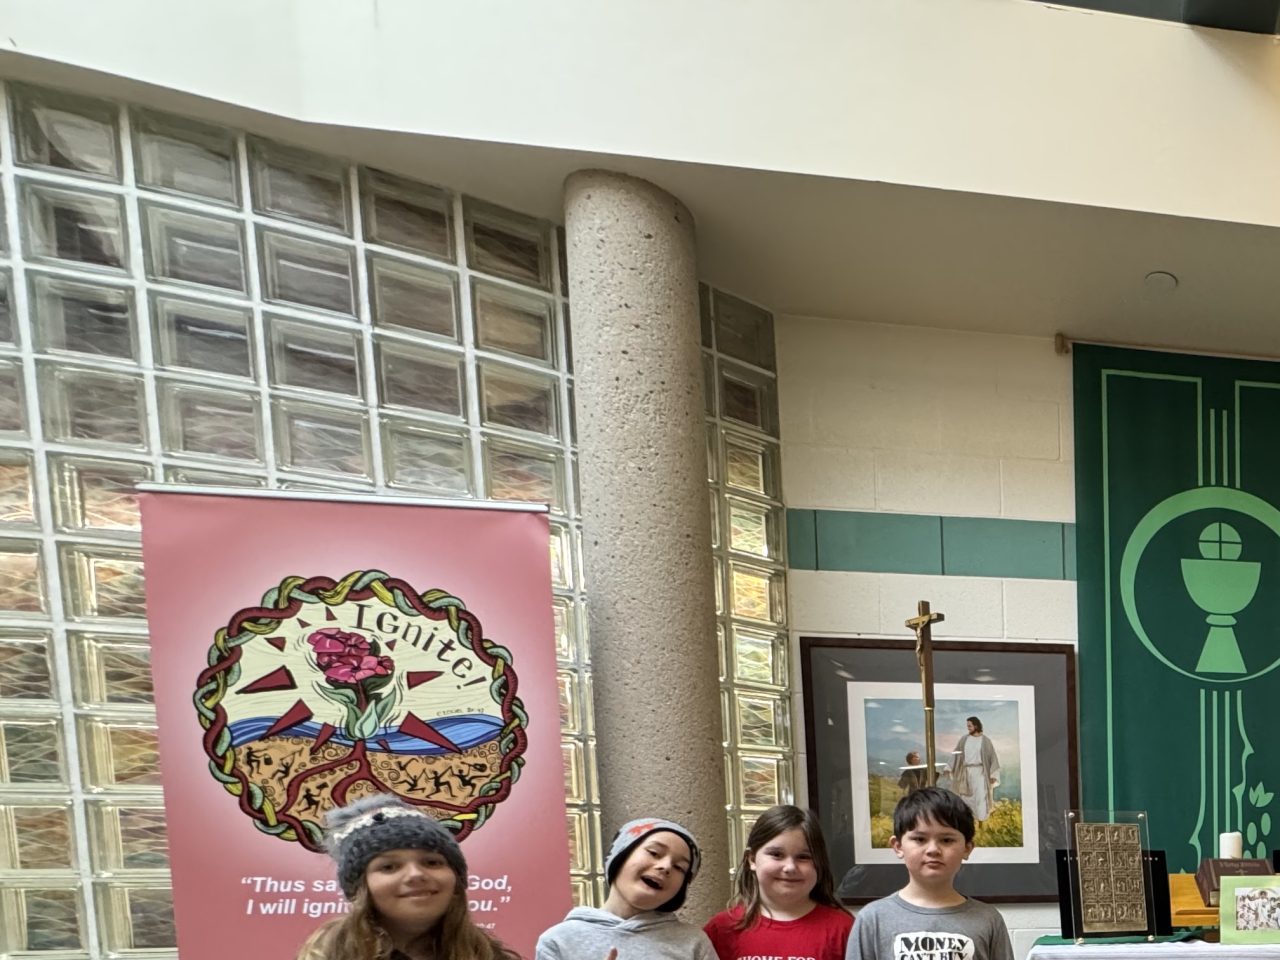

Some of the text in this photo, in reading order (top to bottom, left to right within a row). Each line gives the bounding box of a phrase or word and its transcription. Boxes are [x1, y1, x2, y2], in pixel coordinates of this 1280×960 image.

[311, 879, 345, 896] sa
[467, 874, 512, 893] God,
[246, 896, 511, 918] I will ignit ou.”
[900, 936, 970, 953] MONEY
